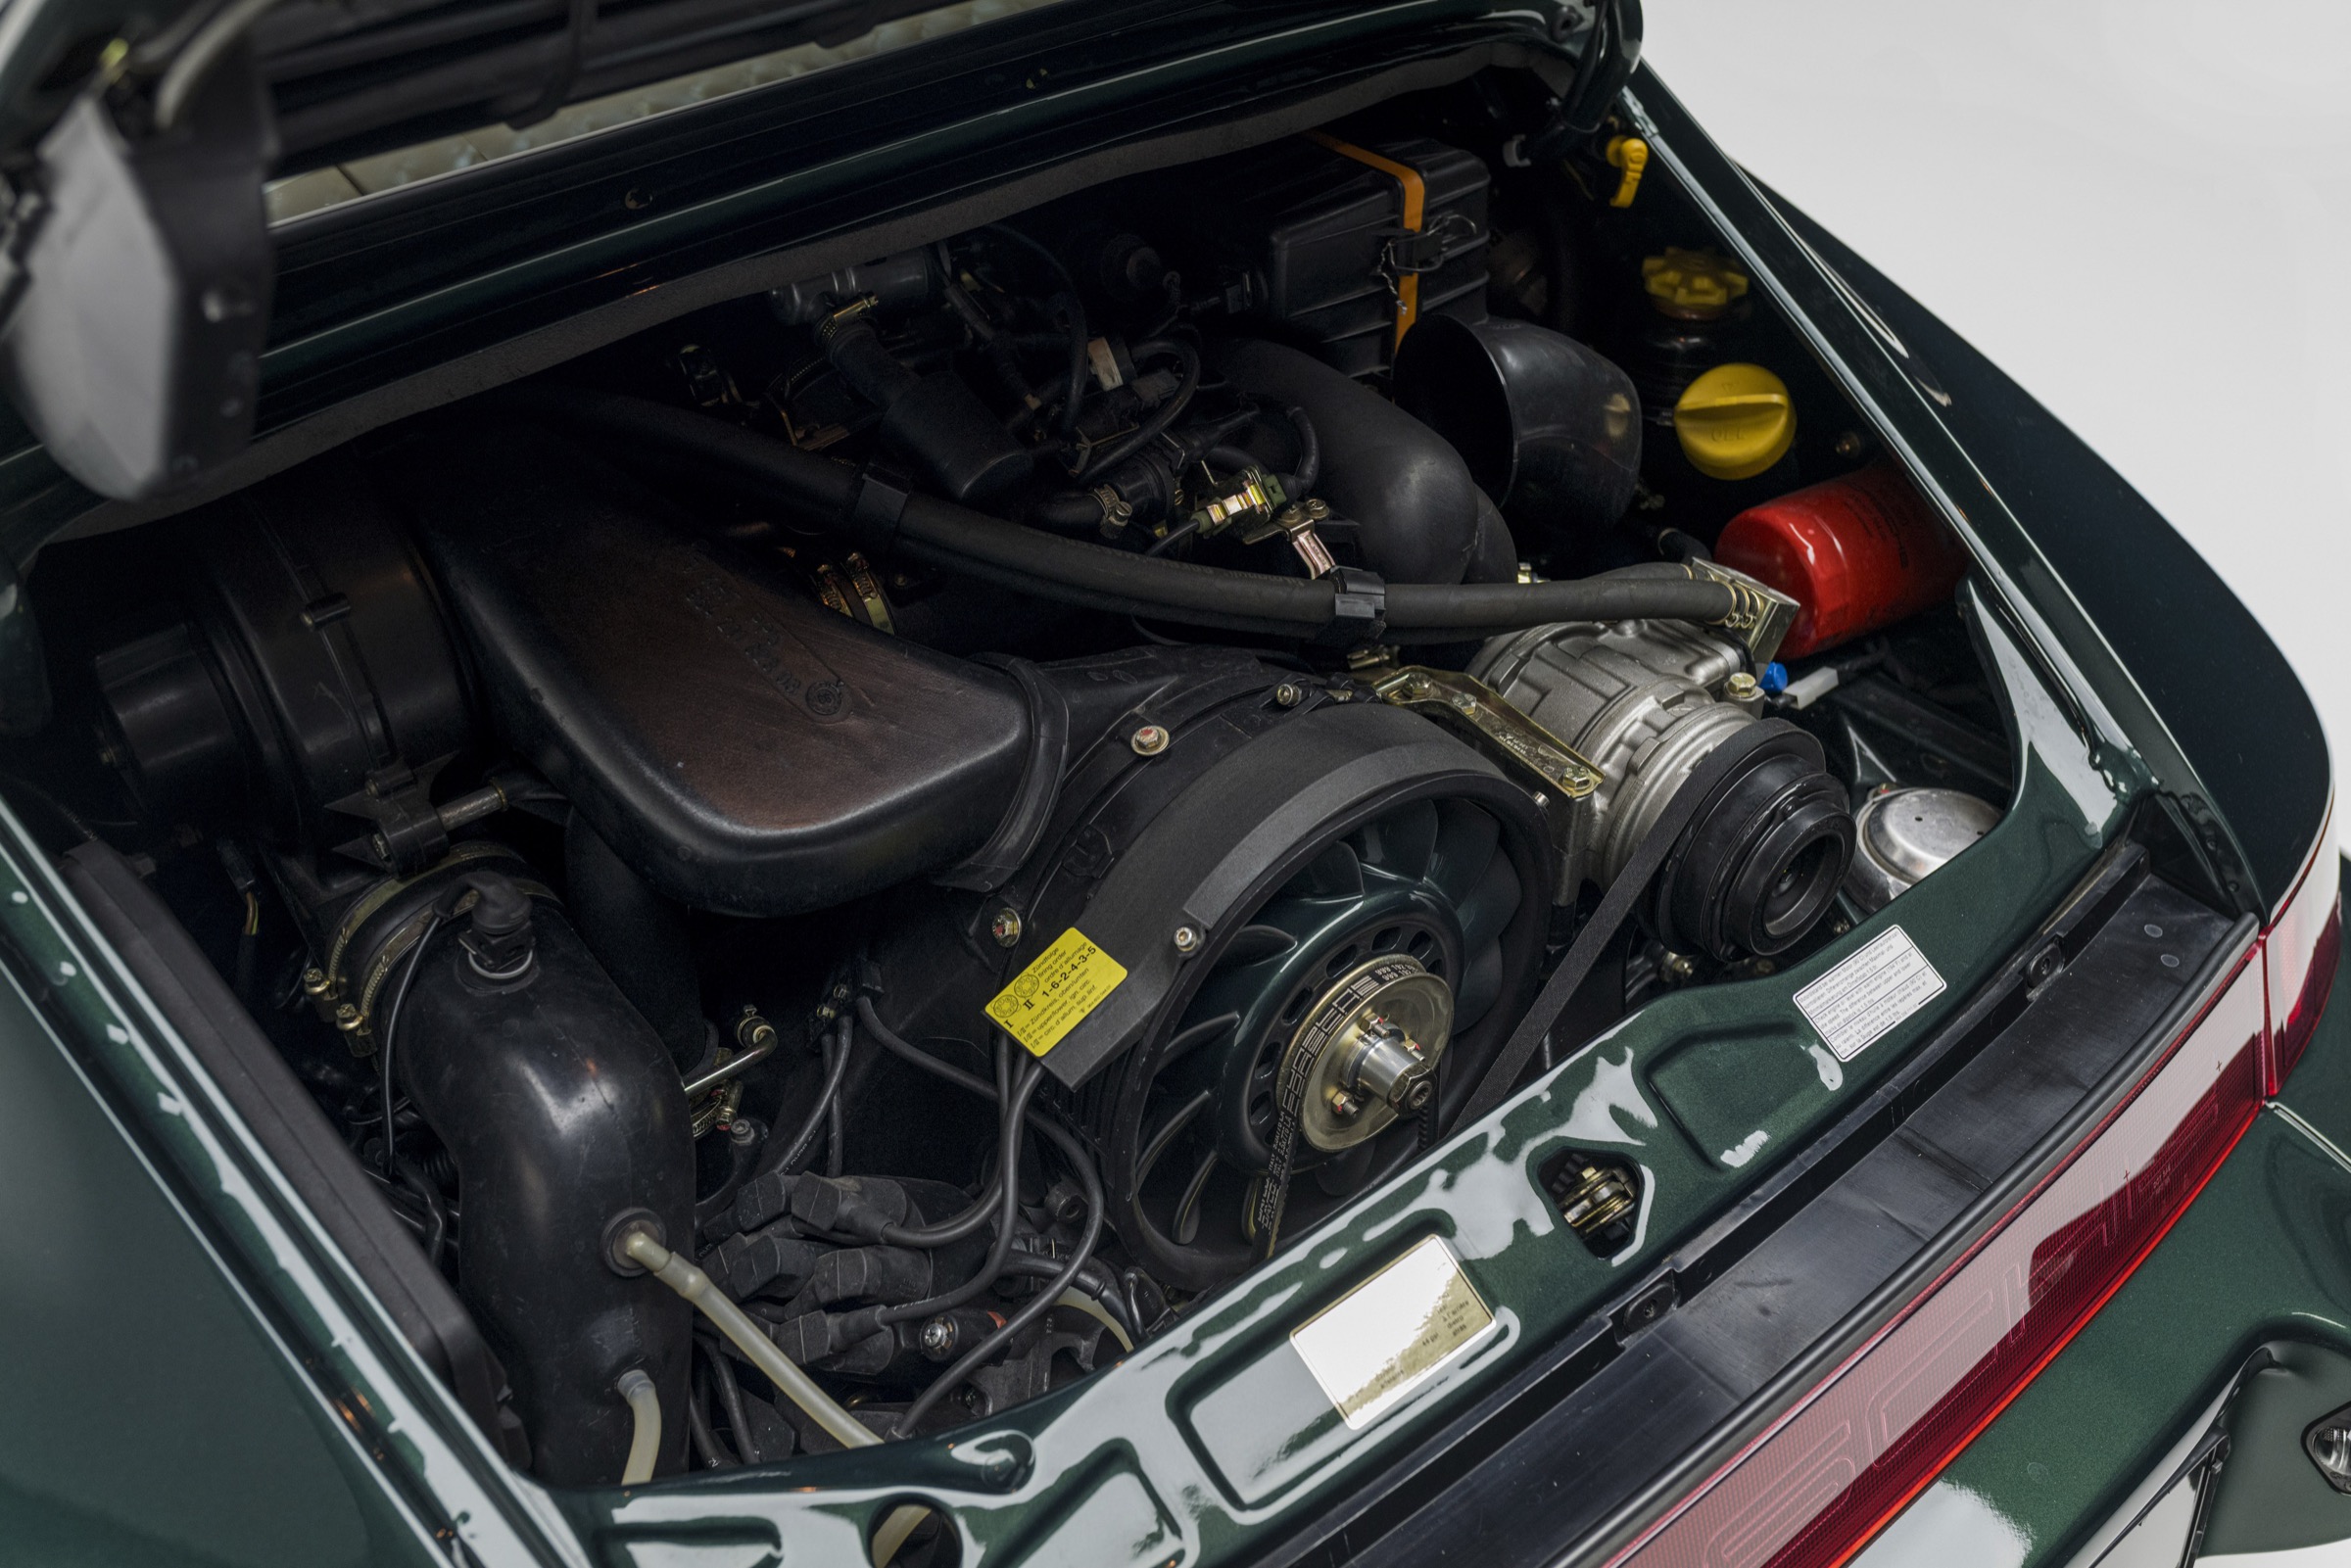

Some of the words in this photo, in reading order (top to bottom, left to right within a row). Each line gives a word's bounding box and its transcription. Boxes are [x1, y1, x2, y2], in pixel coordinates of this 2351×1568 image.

[1035, 962, 1054, 979] firing
[1049, 948, 1068, 965] order
[1039, 944, 1097, 999] 1-6-2-4-3-5
[1042, 967, 1060, 983] ordre
